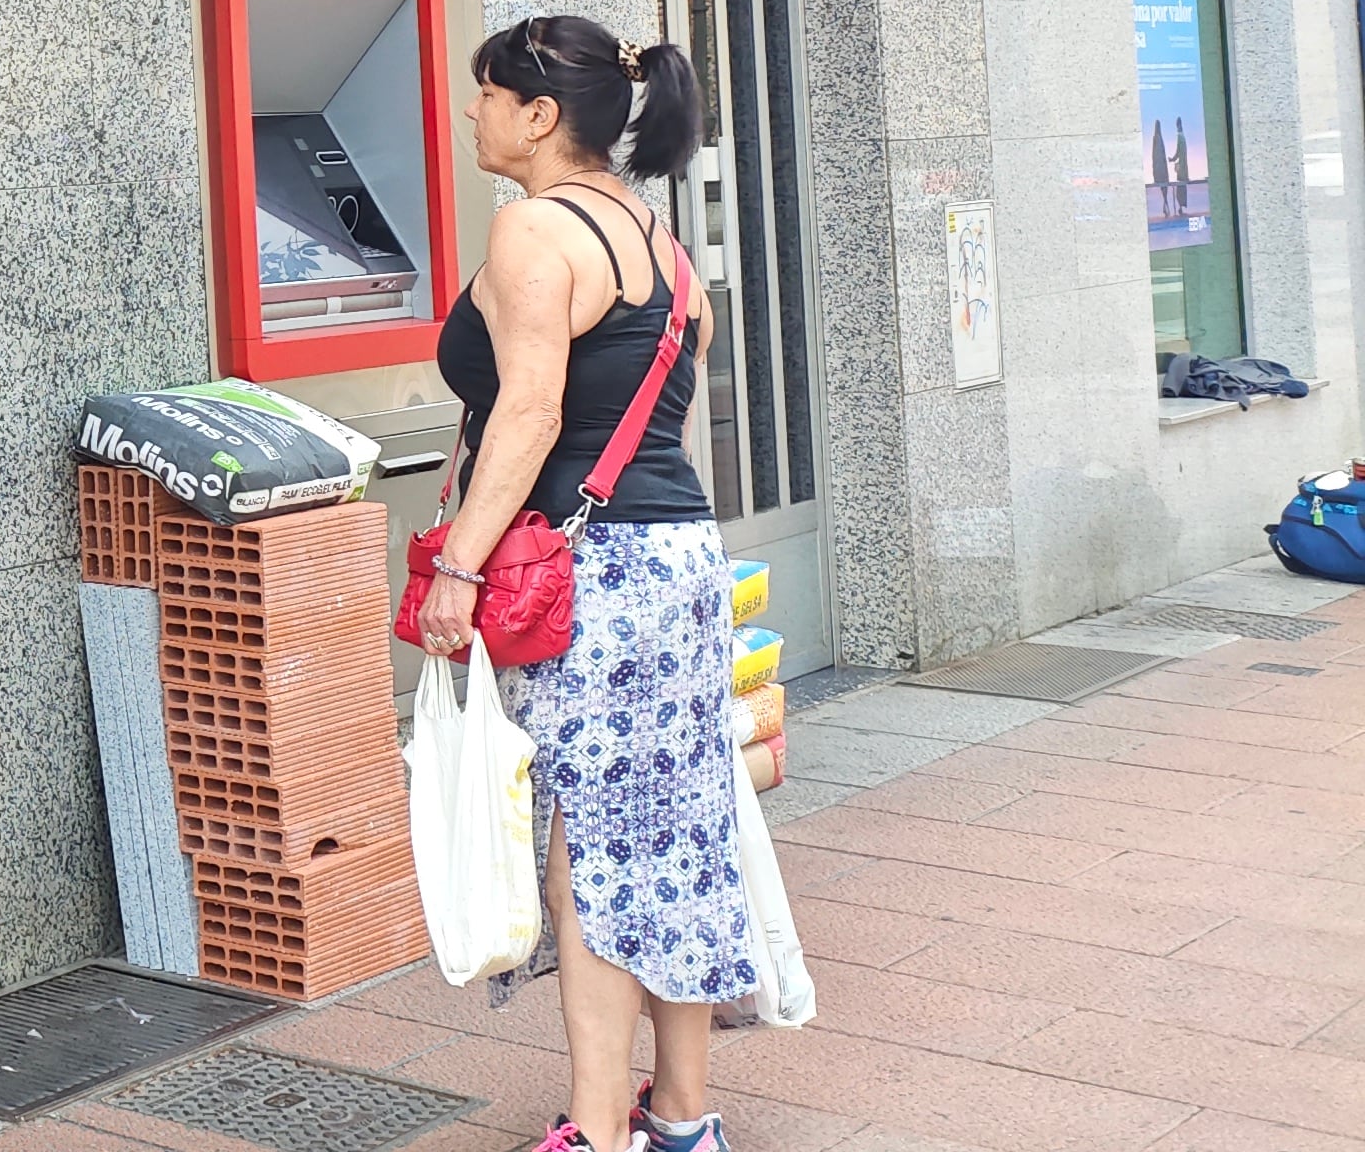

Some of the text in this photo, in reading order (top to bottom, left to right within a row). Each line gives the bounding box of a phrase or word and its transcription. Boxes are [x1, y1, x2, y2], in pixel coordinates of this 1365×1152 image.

[1169, 0, 1193, 23] valor
[131, 396, 226, 440] Molins
[80, 412, 199, 501] Molins
